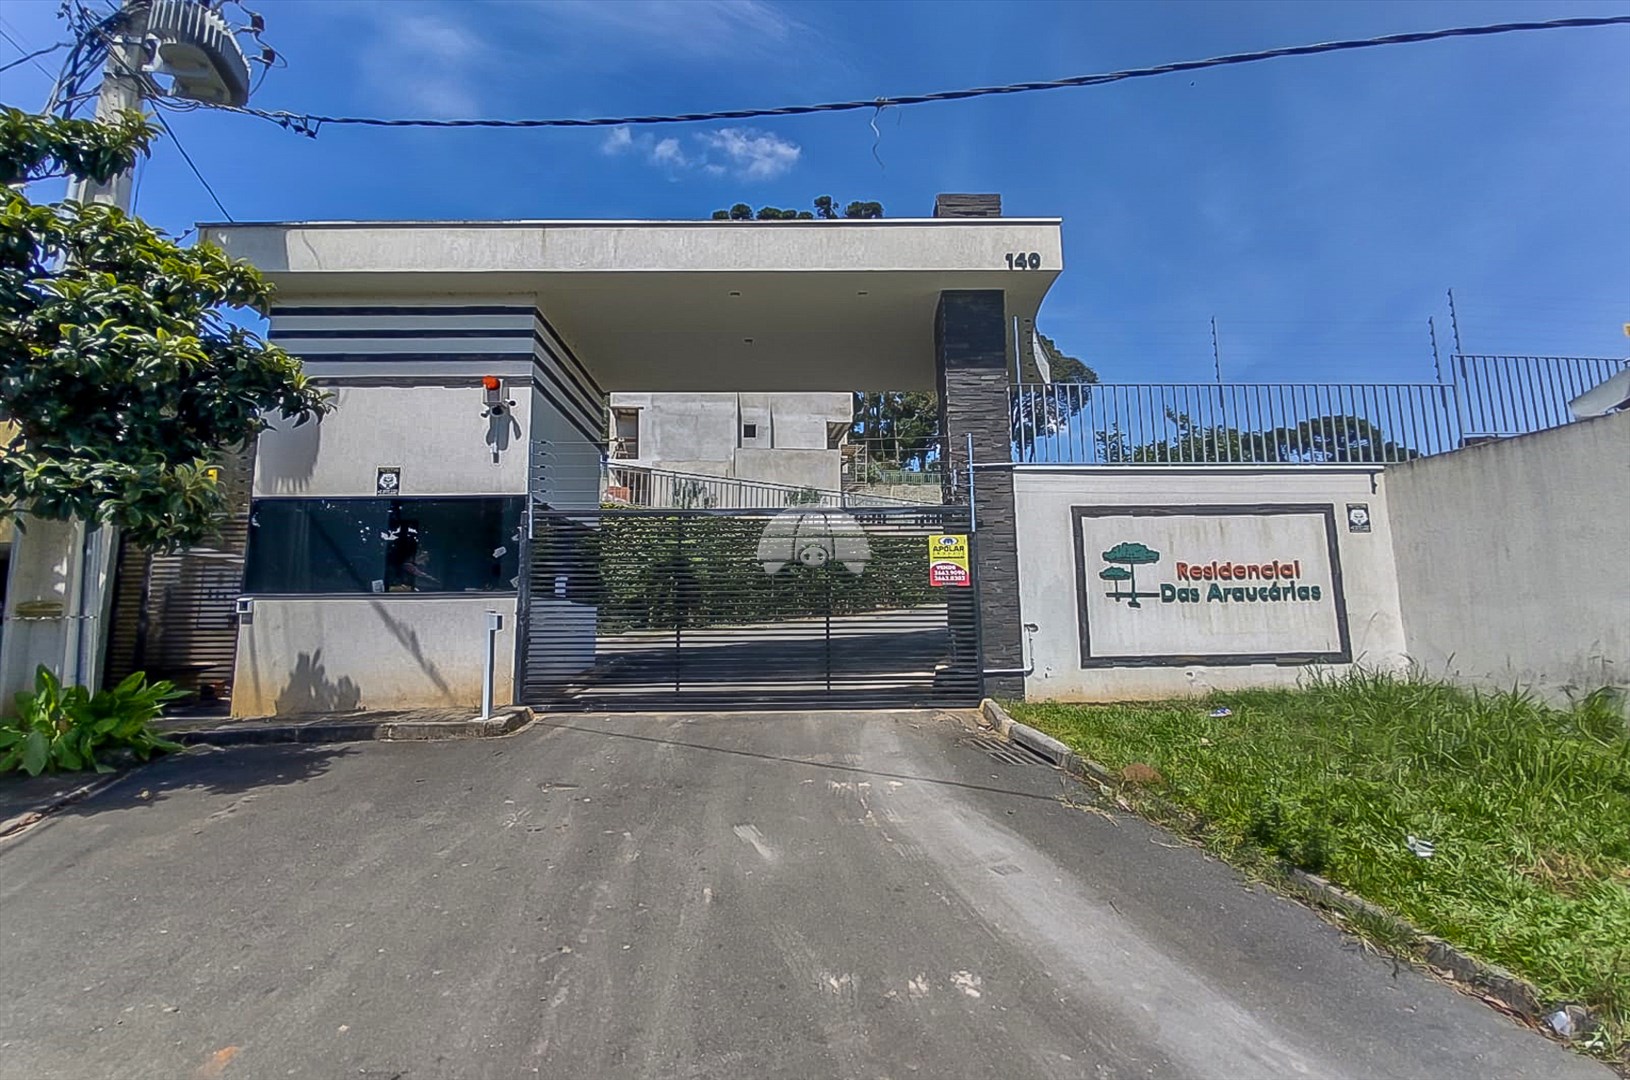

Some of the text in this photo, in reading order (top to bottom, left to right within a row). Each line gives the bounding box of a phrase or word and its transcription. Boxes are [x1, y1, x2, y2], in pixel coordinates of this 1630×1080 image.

[1005, 252, 1041, 271] 140
[1176, 560, 1301, 581] Residencial
[1160, 581, 1321, 603] Das Araucárias
